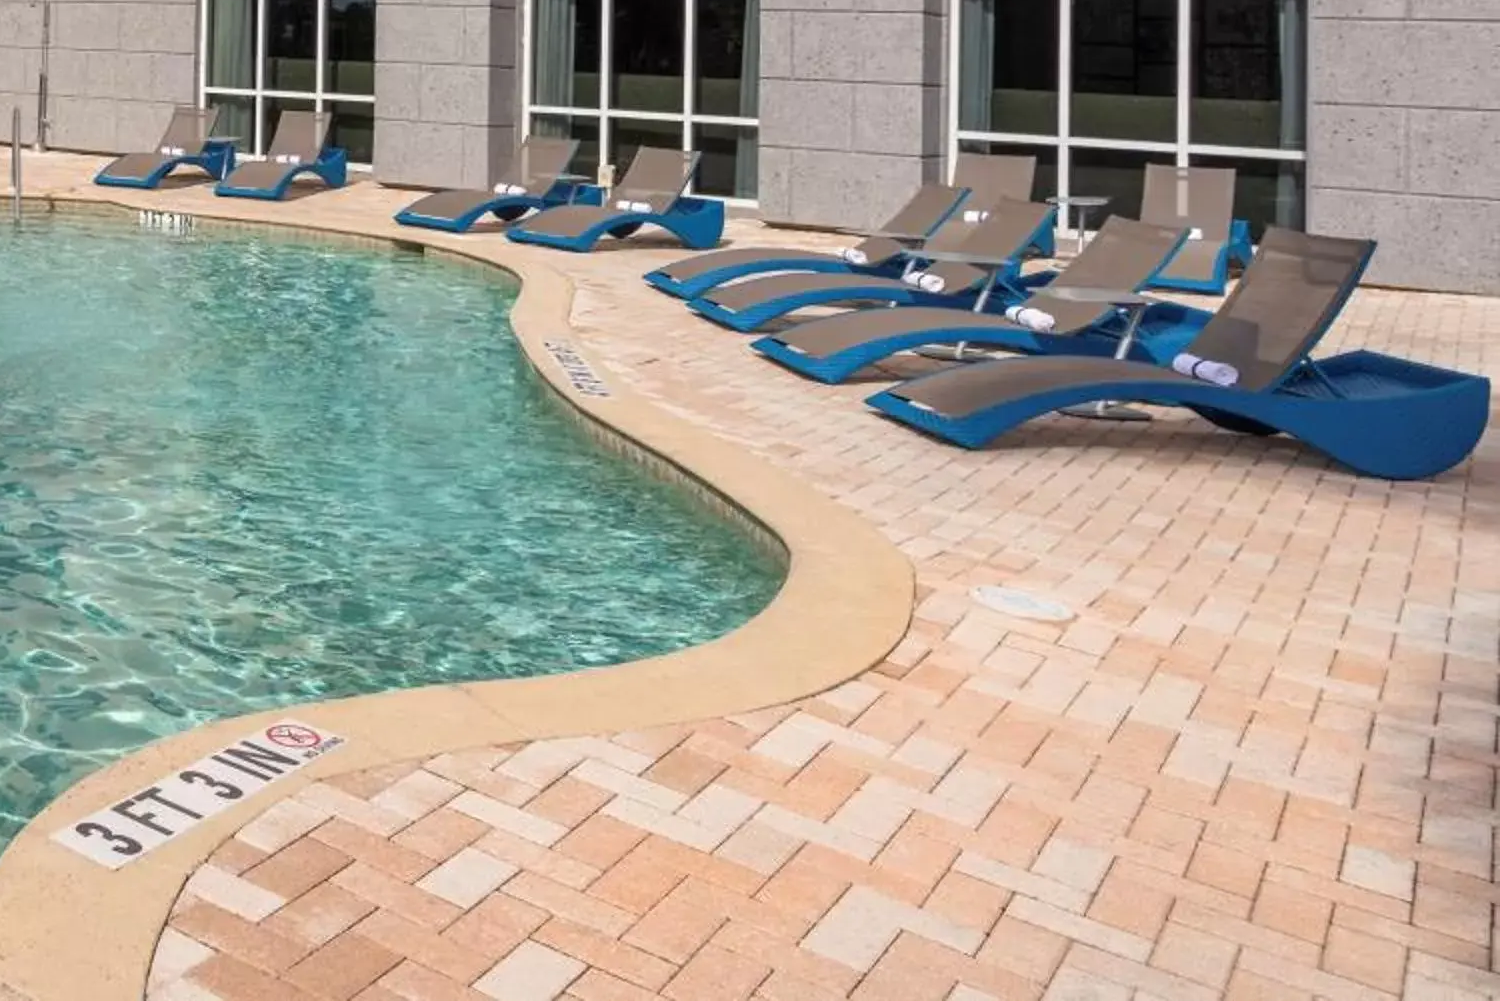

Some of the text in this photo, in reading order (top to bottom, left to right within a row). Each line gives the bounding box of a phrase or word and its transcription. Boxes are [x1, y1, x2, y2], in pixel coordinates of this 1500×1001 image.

[75, 822, 143, 856] 3
[111, 786, 204, 836] FT
[179, 770, 243, 800] 3
[212, 740, 300, 782] IN
